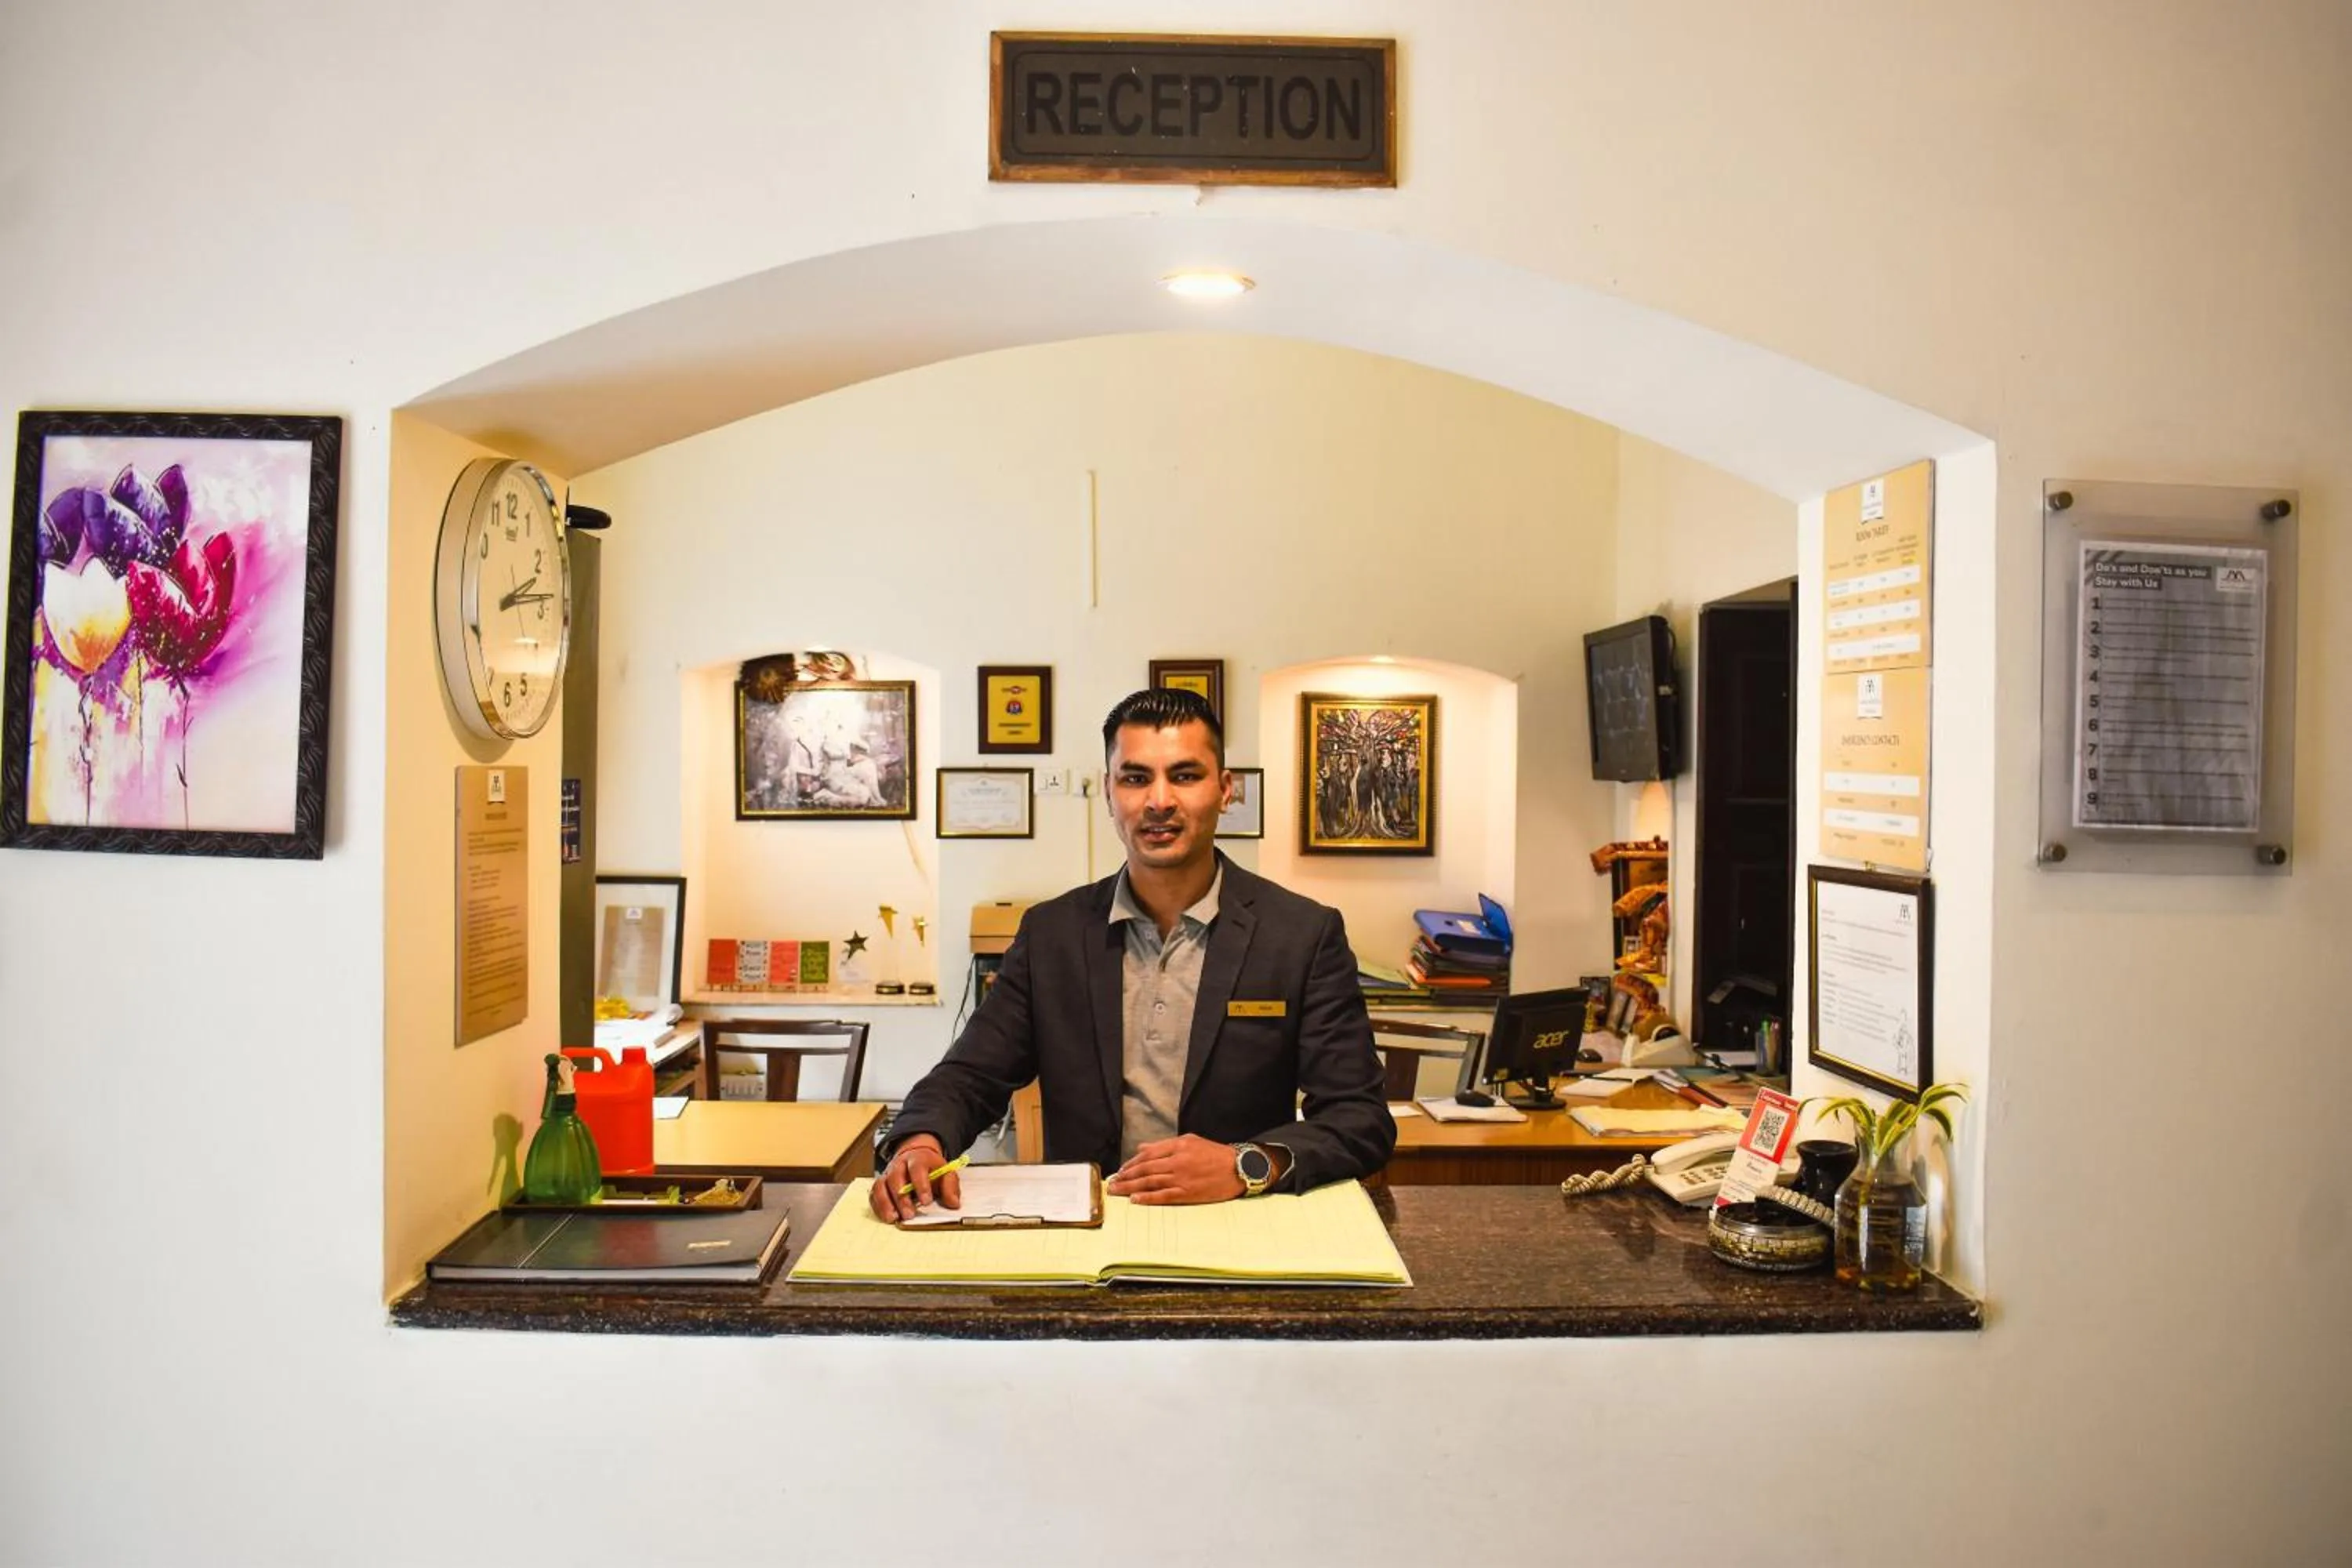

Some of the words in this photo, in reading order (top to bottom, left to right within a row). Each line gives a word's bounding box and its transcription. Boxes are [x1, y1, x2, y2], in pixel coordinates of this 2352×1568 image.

[1025, 72, 1362, 141] RECEPTION
[506, 492, 518, 520] 12
[491, 501, 500, 527] 11
[524, 512, 531, 538] 1
[534, 548, 543, 575] 2
[2119, 564, 2138, 573] and
[2095, 576, 2118, 588] Stay
[2120, 579, 2143, 587] with
[2092, 597, 2100, 610] 1
[2090, 620, 2100, 634] 2
[2089, 670, 2099, 683] 4
[520, 673, 528, 696] 5
[503, 681, 511, 707] 6
[2089, 694, 2099, 708] 5
[2089, 718, 2098, 732] 6
[2088, 742, 2097, 756] 7
[2088, 768, 2097, 781] 8
[2087, 792, 2097, 805] 9
[1533, 1030, 1570, 1049] acer
